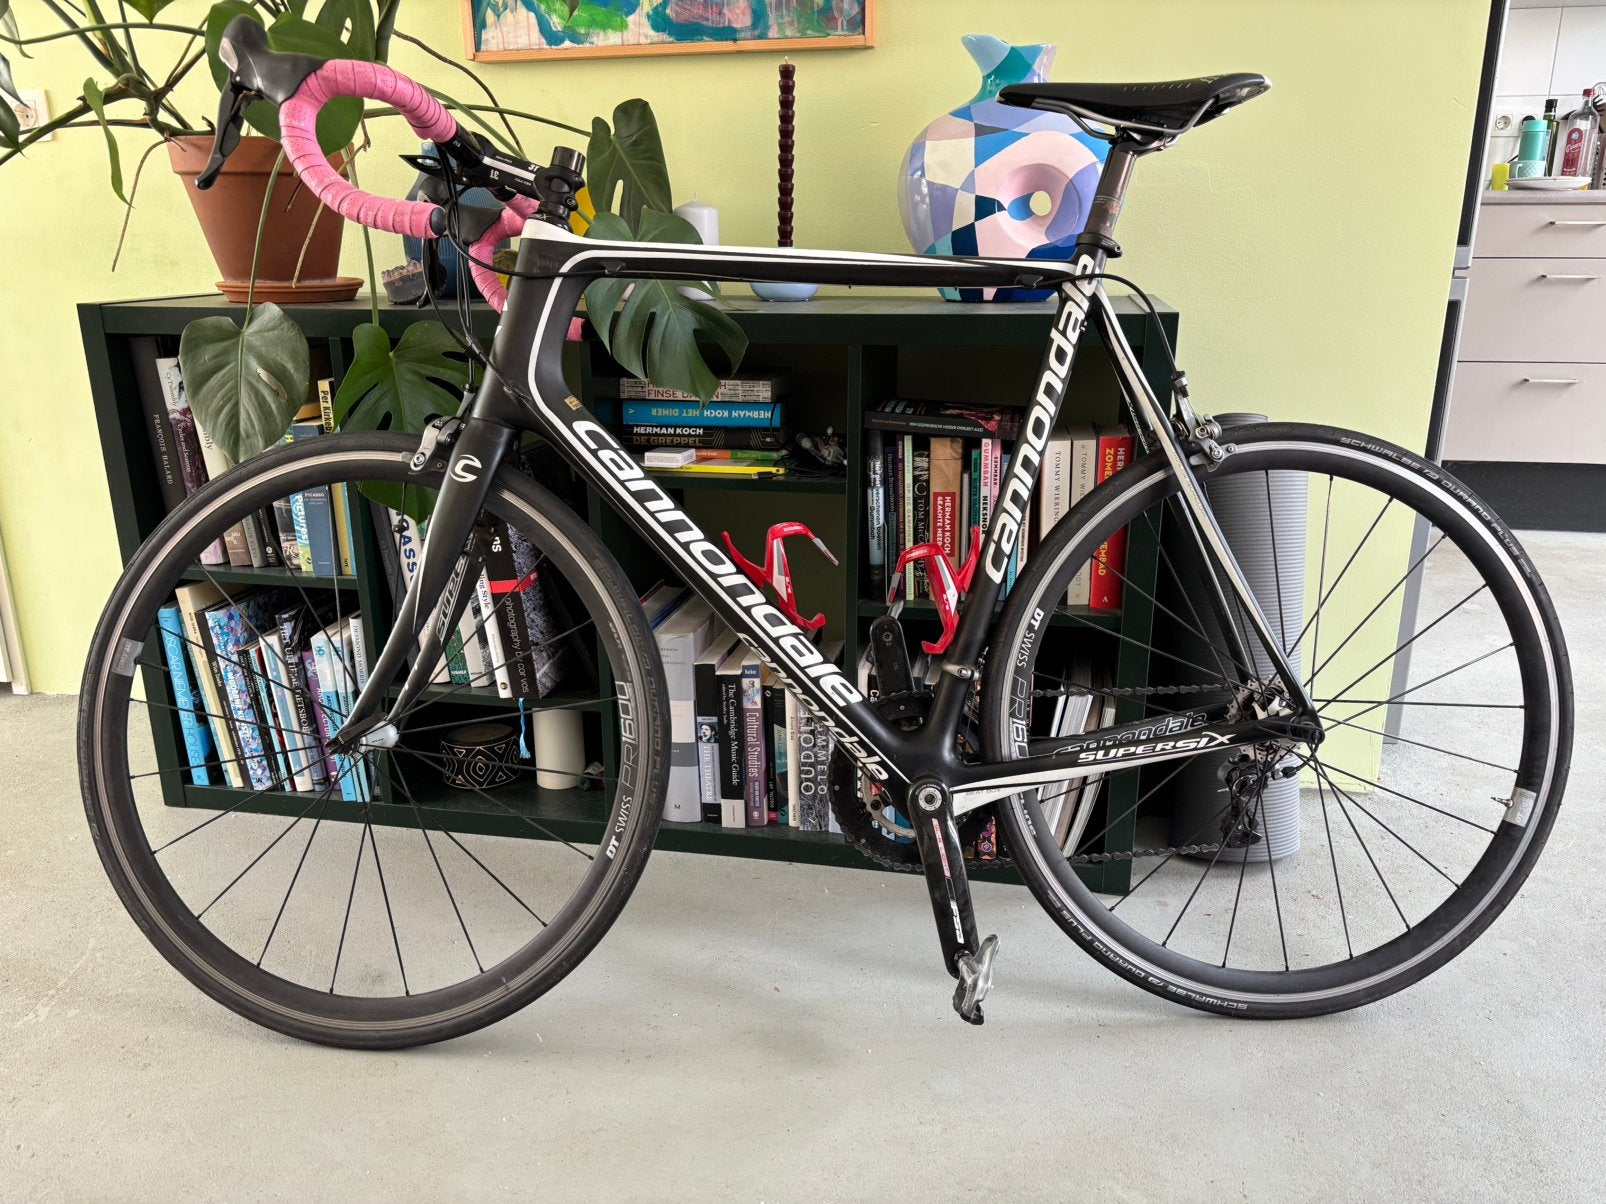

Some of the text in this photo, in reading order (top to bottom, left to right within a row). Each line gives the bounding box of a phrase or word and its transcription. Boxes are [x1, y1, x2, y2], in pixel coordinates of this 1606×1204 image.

[163, 371, 178, 407] Cy Twombly
[319, 389, 330, 404] Per
[647, 389, 679, 399] FINSE
[633, 426, 704, 435] HERMAN KOCH
[651, 407, 772, 419] HERMAN KOCH HET DINER
[985, 254, 1098, 585] cannondale
[153, 414, 174, 486] FRANÇOIS HALARD
[175, 423, 192, 473] Cycles and Seasons
[633, 436, 703, 446] DE GREPPEL
[904, 438, 912, 474] GUMMBAH
[886, 453, 895, 512] Herman Brusselmans
[1079, 452, 1087, 479] TOMMY
[1104, 447, 1114, 480] ZOME
[905, 482, 910, 494] OP
[906, 496, 911, 506] DE
[979, 441, 990, 535] GUMMBAH NEKSNOR
[1052, 450, 1061, 526] TOMMY WIERING
[1340, 436, 1520, 557] SCHWALBE DURANO PLUS
[293, 494, 310, 540] Pictures
[868, 505, 876, 540] Gummbah
[935, 496, 943, 526] GEACHTE
[942, 496, 952, 554] HERMAN KOCH
[572, 420, 863, 707] cannondale
[917, 521, 926, 569] McCAHY
[479, 589, 492, 610] Style
[1031, 607, 1044, 630] DT
[500, 596, 523, 650] photography
[238, 654, 248, 676] JACKON
[350, 624, 367, 684] DESMOND MORRIS
[1017, 629, 1036, 669] SWISS
[210, 660, 223, 687] Wim Izaks
[516, 662, 527, 678] cor
[519, 677, 530, 693] vos
[226, 671, 242, 709] MODERNE
[738, 632, 889, 781] cannondale
[726, 683, 739, 785] The Cambridge Music Guide
[746, 711, 761, 777] Cultural Studies
[1077, 731, 1237, 763] SUPERSIX
[702, 745, 712, 801] THE THEATRE
[606, 835, 619, 860] DT
[615, 795, 633, 833] SWISS
[1060, 909, 1248, 1010] SCHWALBE DURANO PLUS
